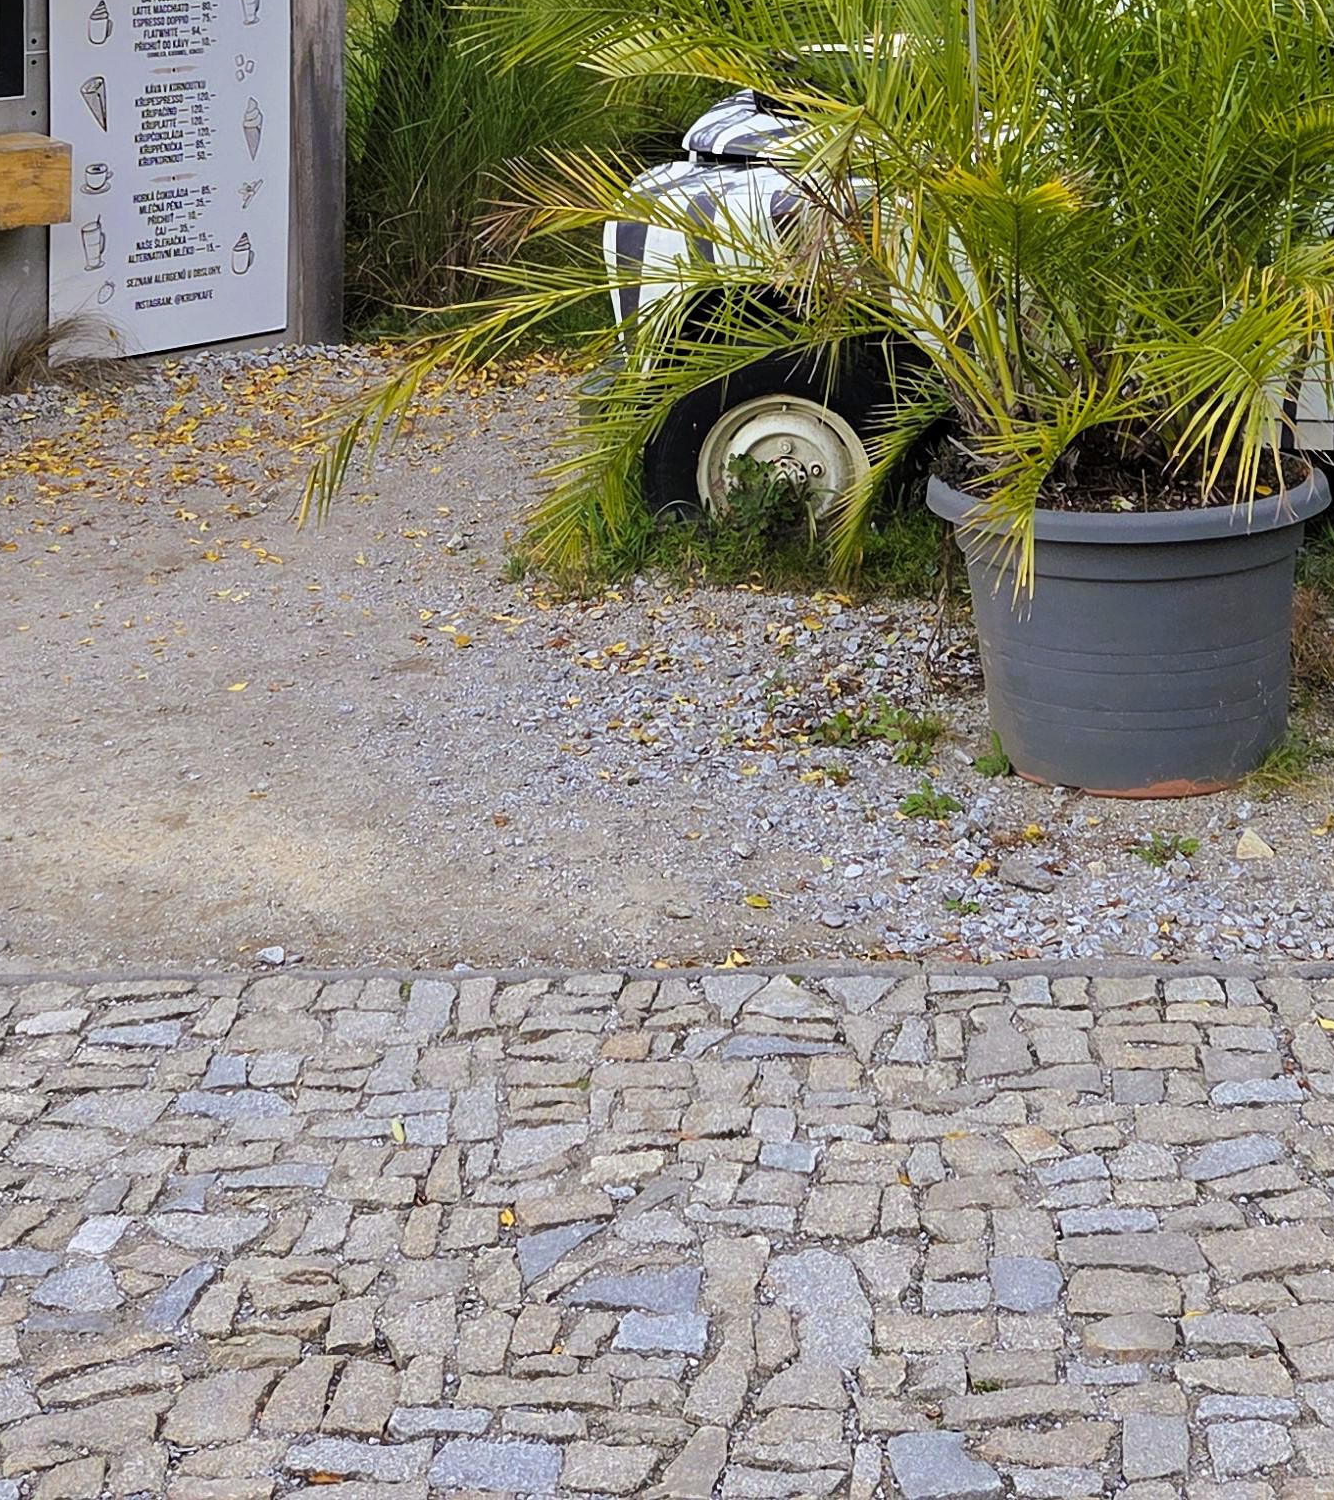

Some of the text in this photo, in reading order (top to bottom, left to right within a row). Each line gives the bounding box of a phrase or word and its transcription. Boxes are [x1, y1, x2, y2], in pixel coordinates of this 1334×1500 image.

[154, 4, 189, 14] MACCHIATO
[133, 18, 164, 28] ESPRESSO
[167, 16, 189, 25] DOPPIO
[144, 28, 178, 39] FLATWHITE
[163, 40, 171, 49] DO
[173, 39, 189, 48] KÁVY
[156, 188, 188, 201] ČOKOLÁDA
[155, 225, 166, 236] ČAJ
[155, 236, 186, 248] ŠLEHAČKA
[127, 276, 153, 288] SEZNAM
[154, 270, 186, 283] ALERGENŮ
